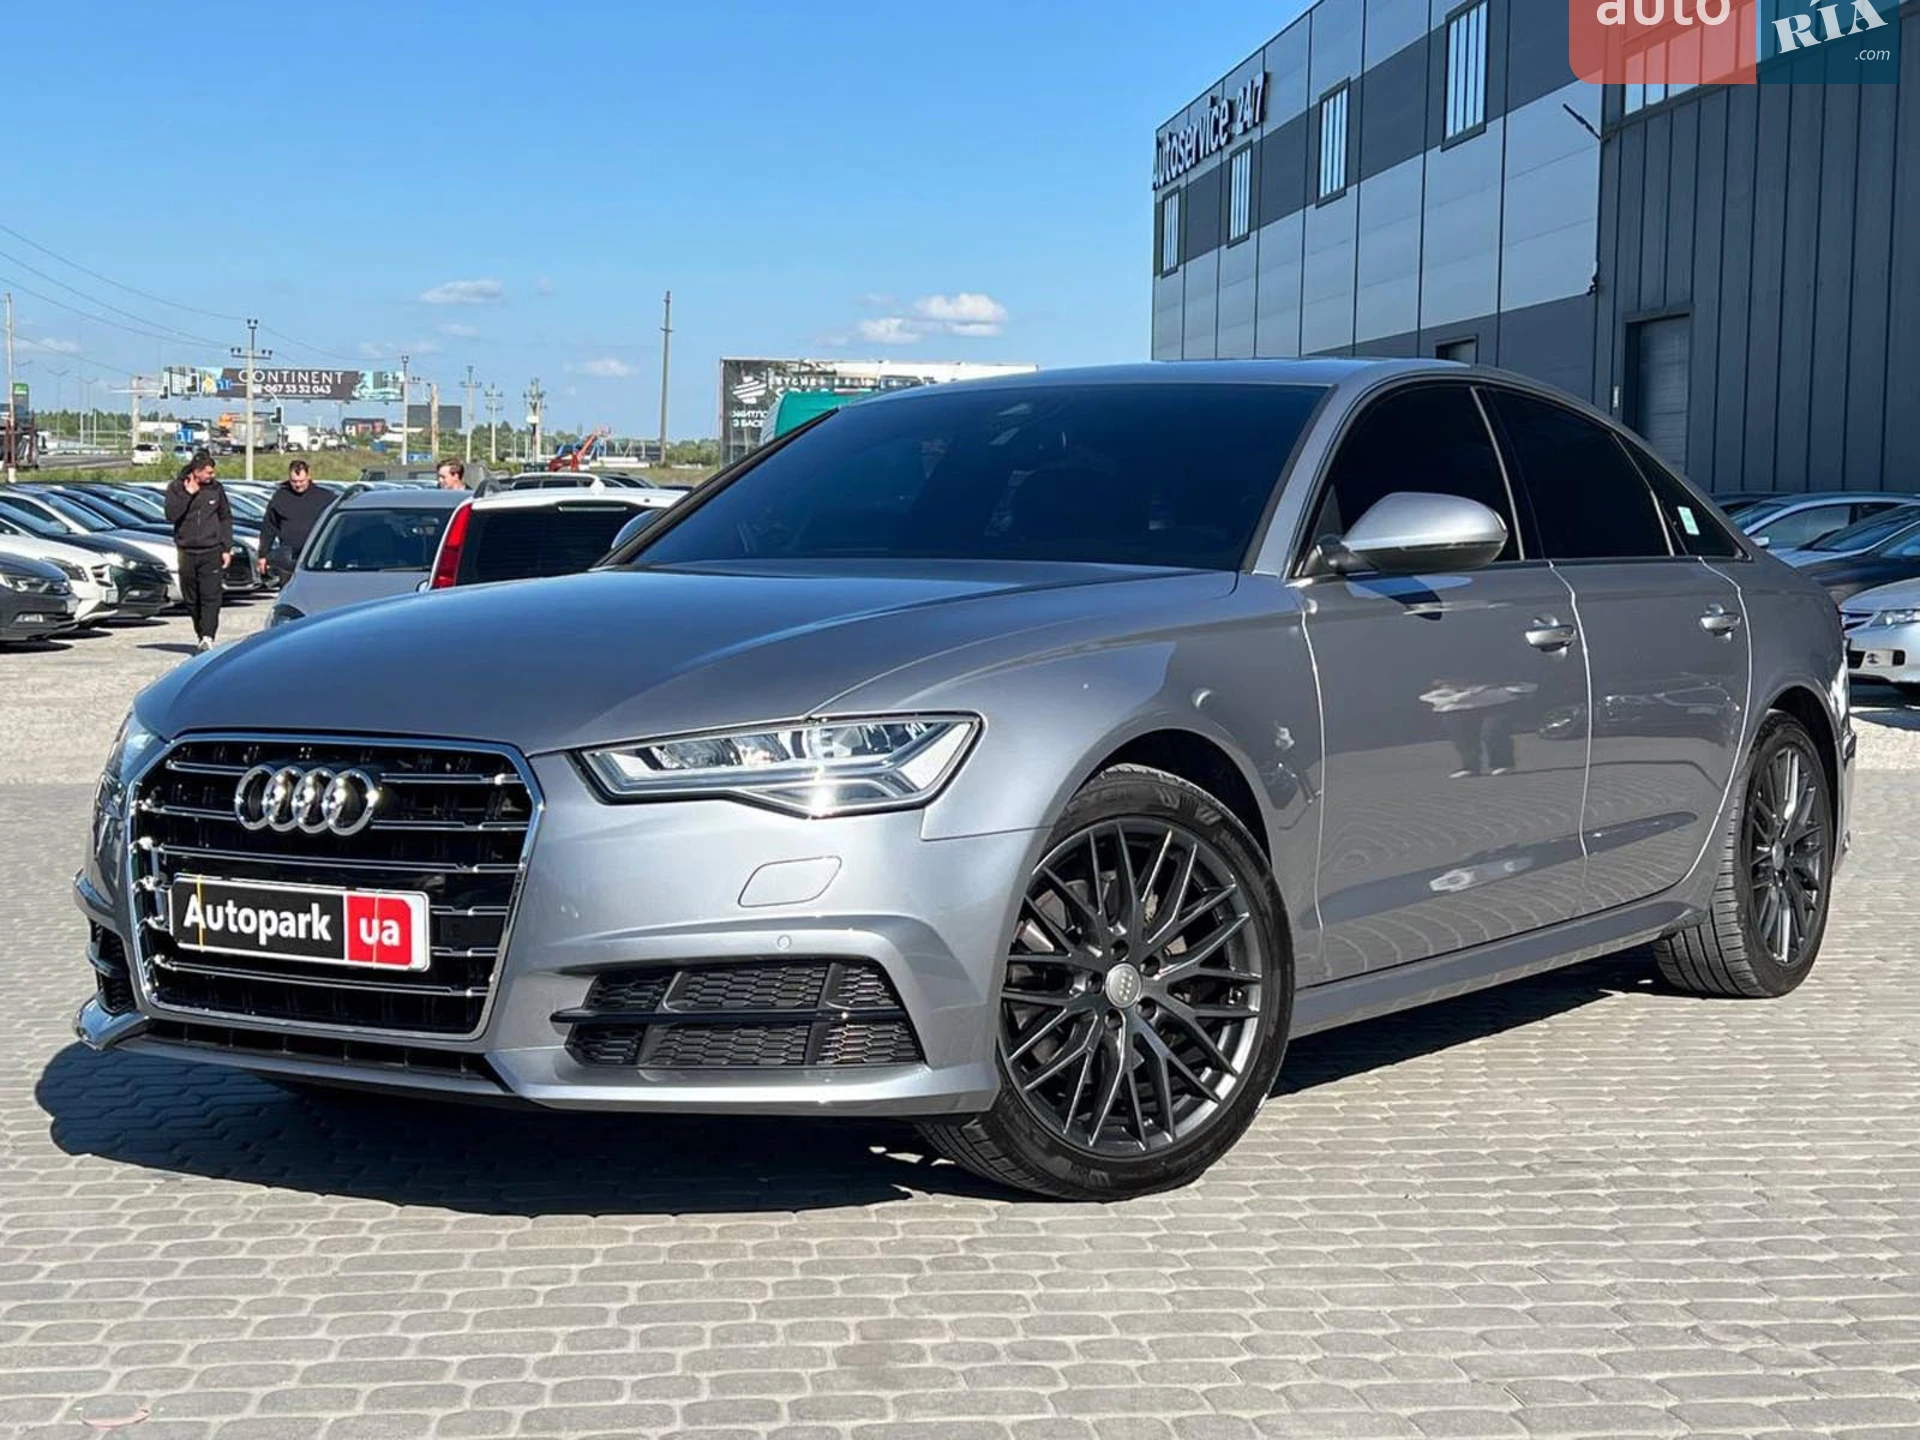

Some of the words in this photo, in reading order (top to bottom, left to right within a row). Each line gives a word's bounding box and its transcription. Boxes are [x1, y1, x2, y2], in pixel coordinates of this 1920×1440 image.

[238, 369, 343, 384] CONTINENT
[184, 894, 332, 946] Autopark
[359, 917, 400, 946] ua
